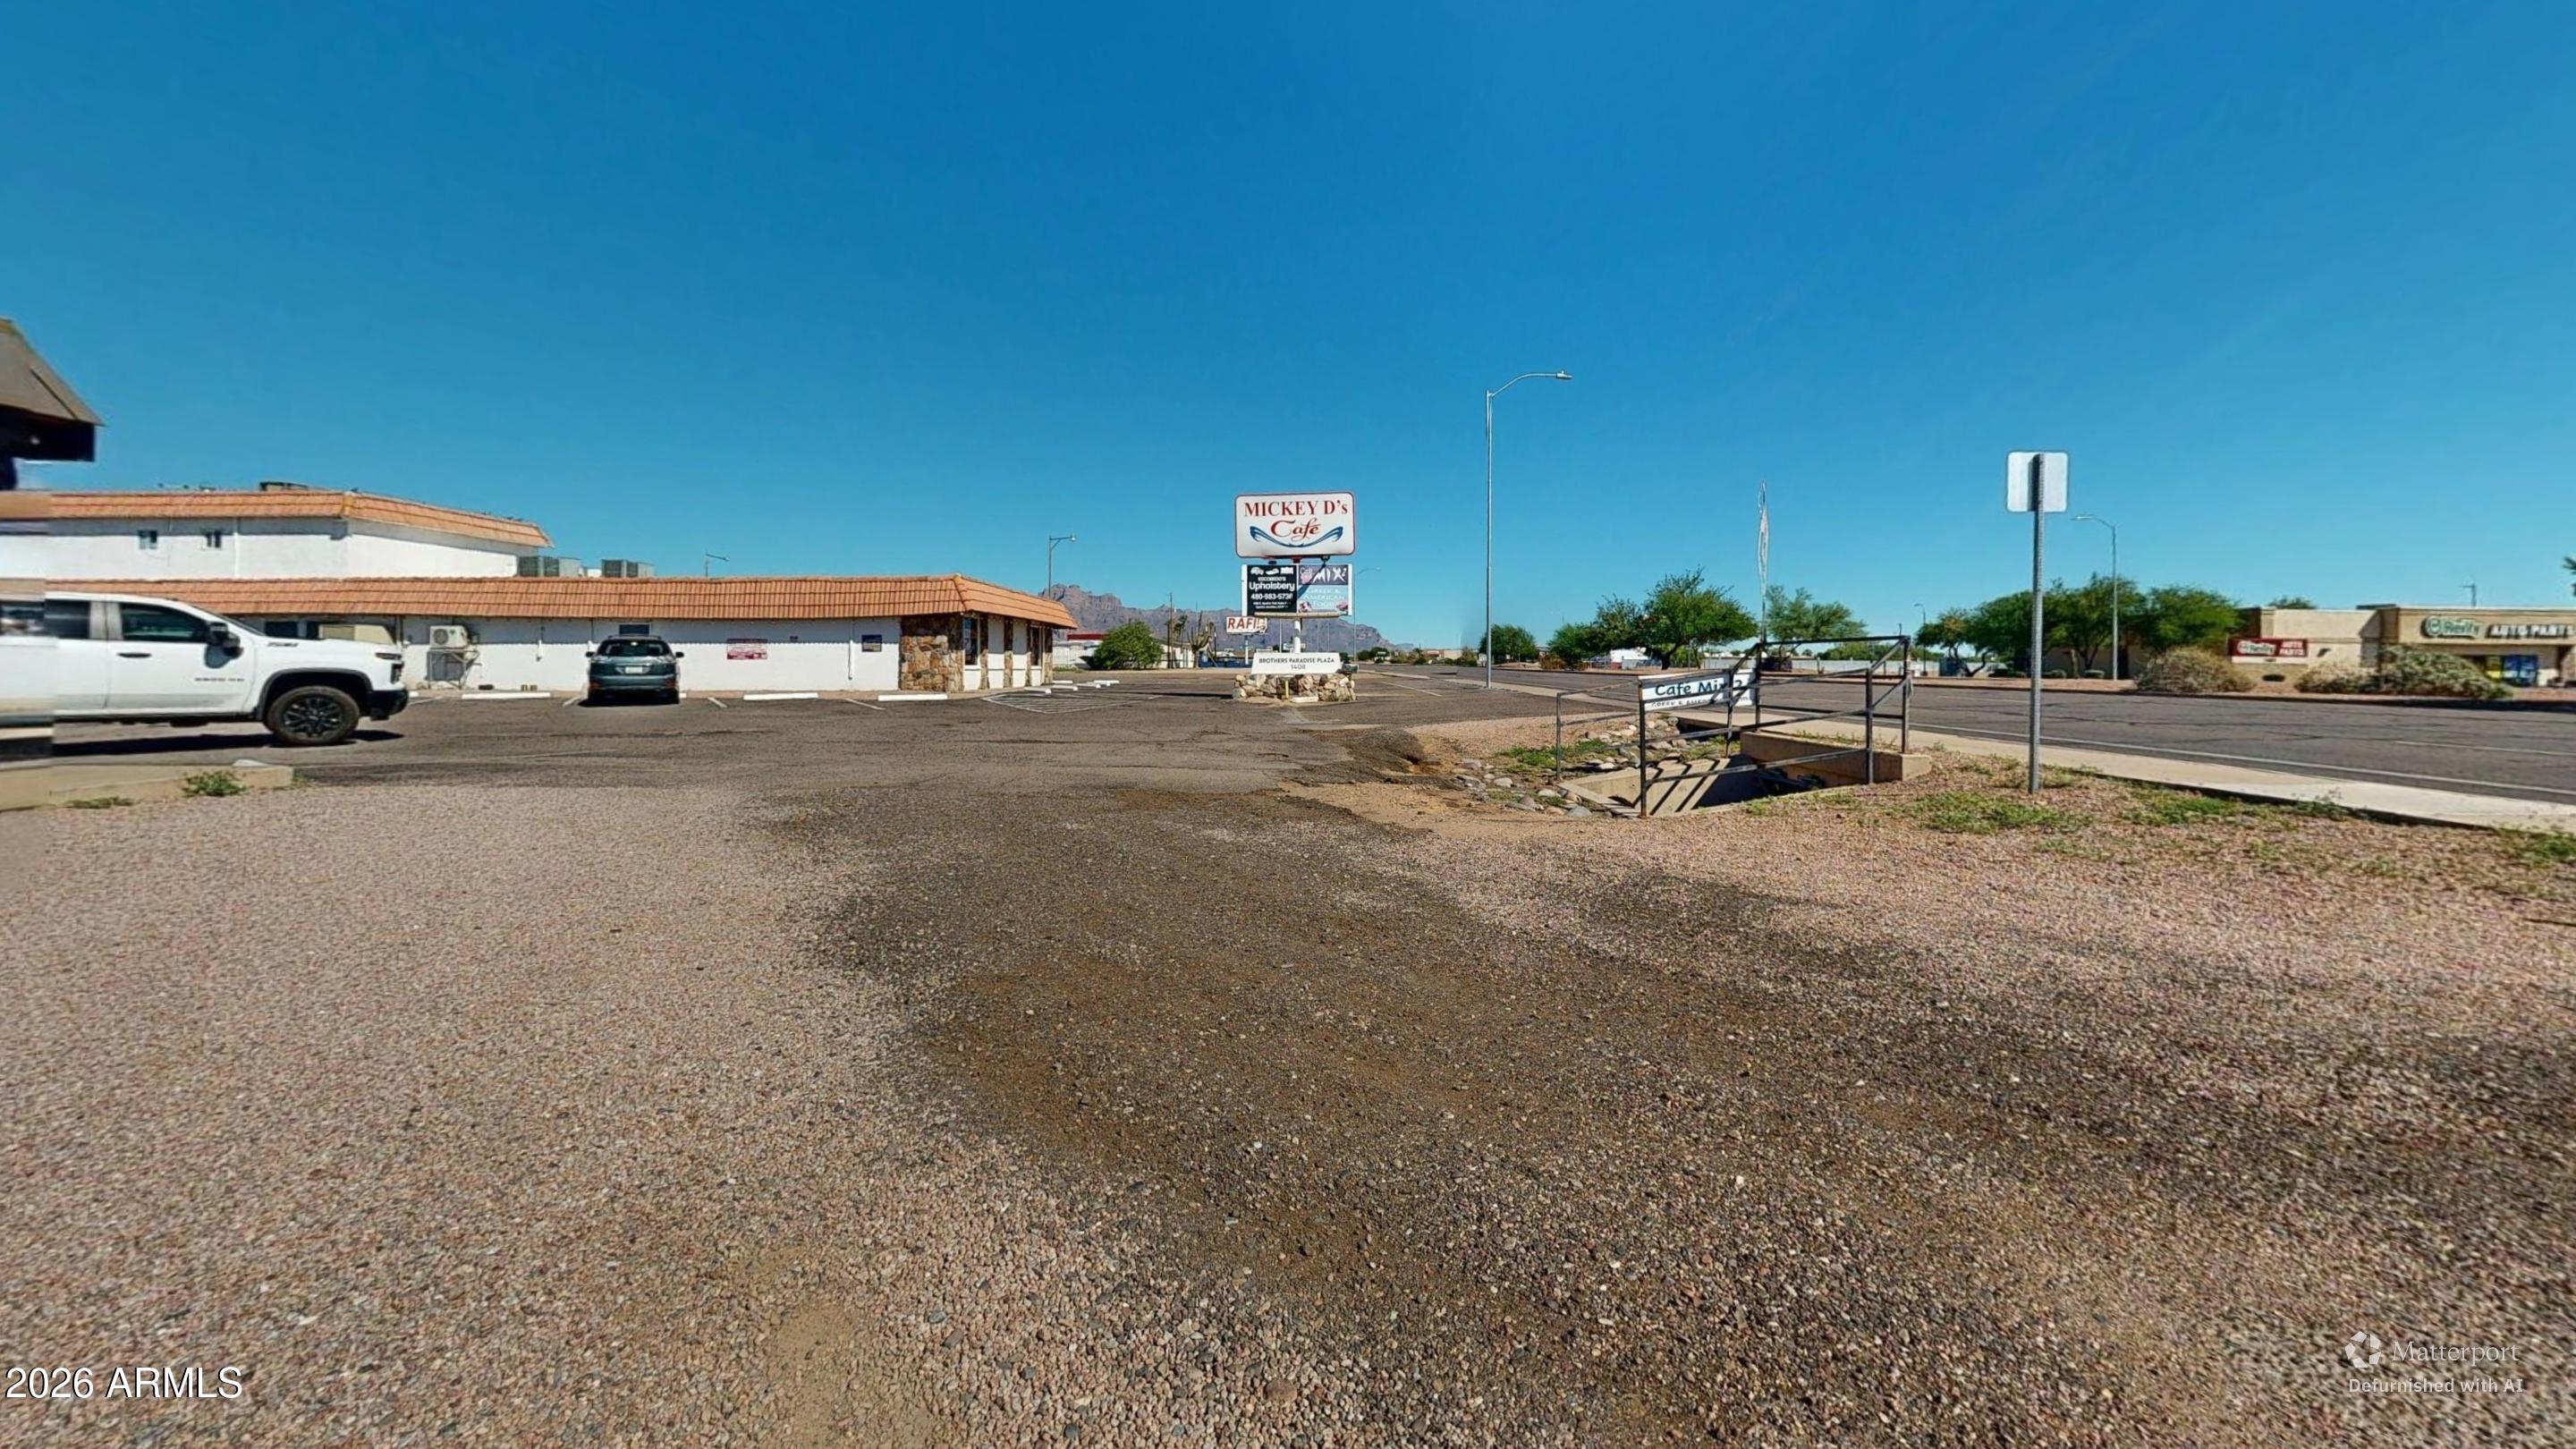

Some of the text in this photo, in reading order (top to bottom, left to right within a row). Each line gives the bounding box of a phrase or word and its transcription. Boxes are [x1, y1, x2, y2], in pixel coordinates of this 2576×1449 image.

[1244, 500, 1348, 516] MICKEY D's
[1249, 581, 1295, 591] Upholstery
